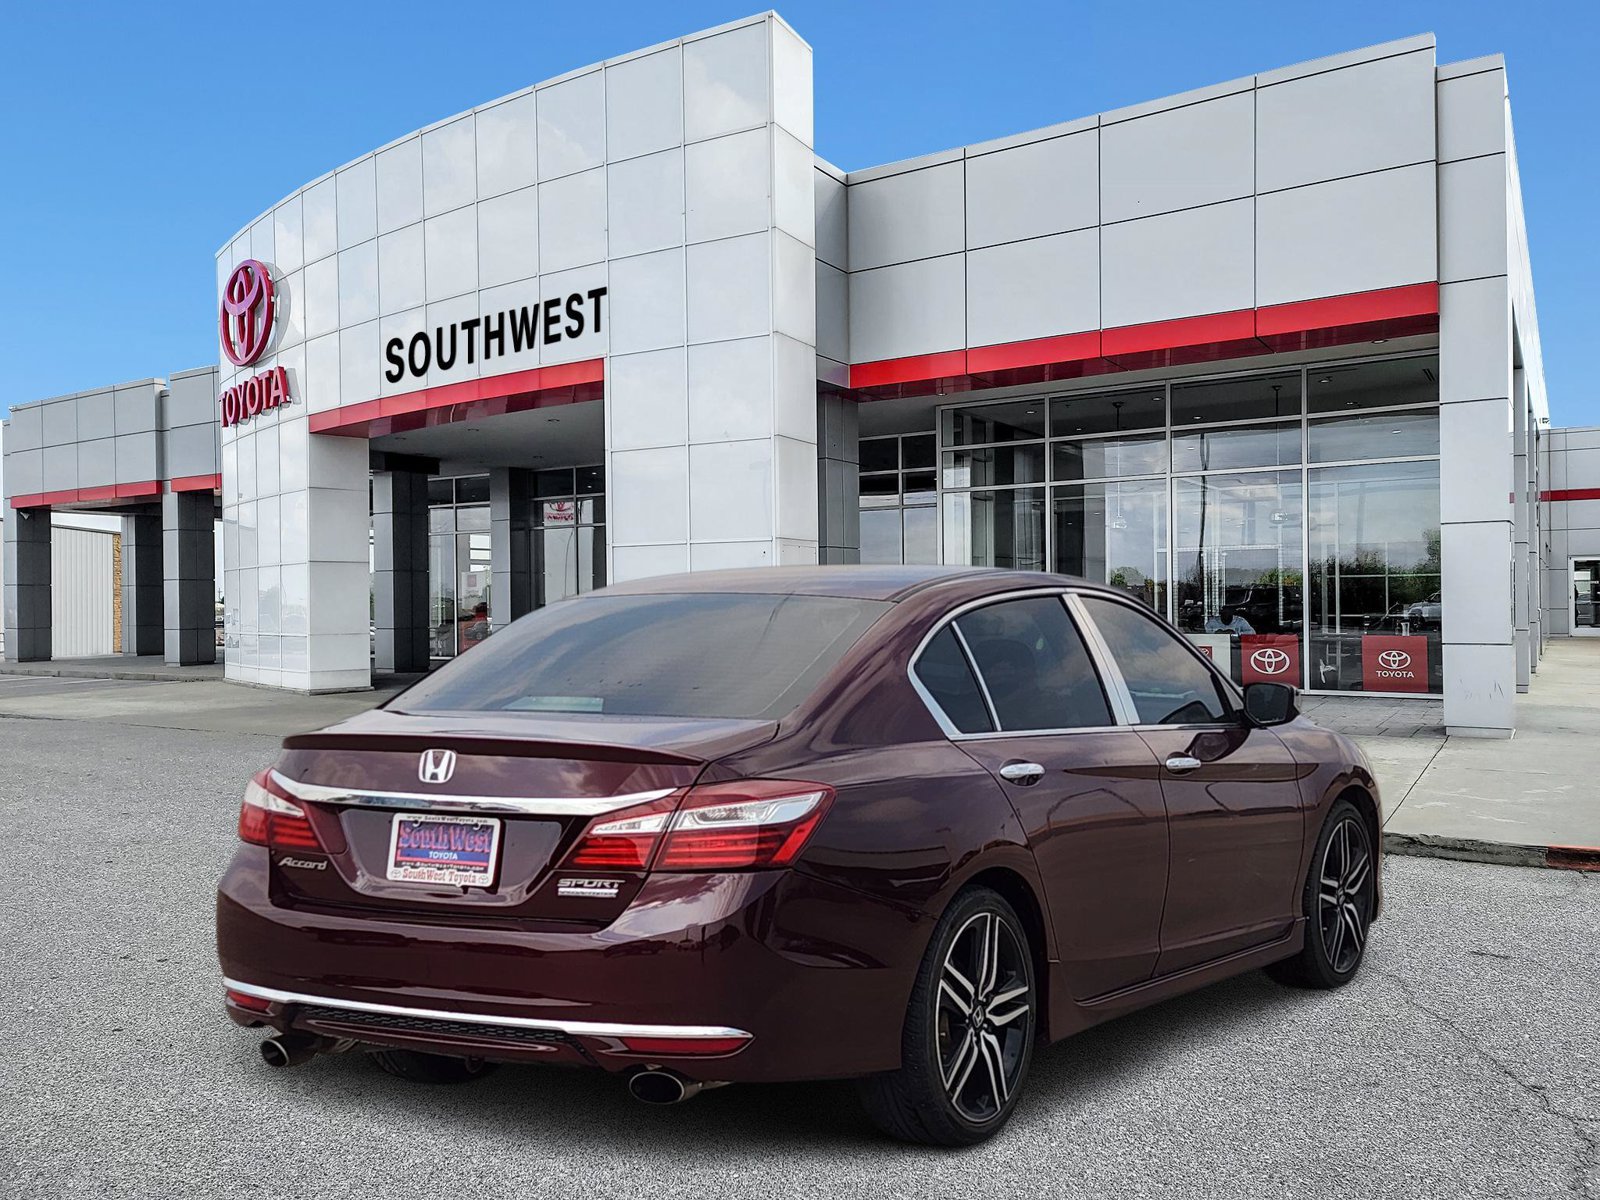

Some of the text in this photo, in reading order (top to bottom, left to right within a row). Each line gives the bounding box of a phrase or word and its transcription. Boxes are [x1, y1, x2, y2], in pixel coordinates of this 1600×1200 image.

[385, 287, 608, 384] SOUTHWEST
[219, 366, 289, 428] TOYOTA
[1375, 670, 1413, 679] TOYOTA
[429, 850, 458, 860] TOYOTA
[278, 857, 328, 871] Accord
[448, 871, 477, 885] Toyota
[557, 878, 626, 889] SPORT
